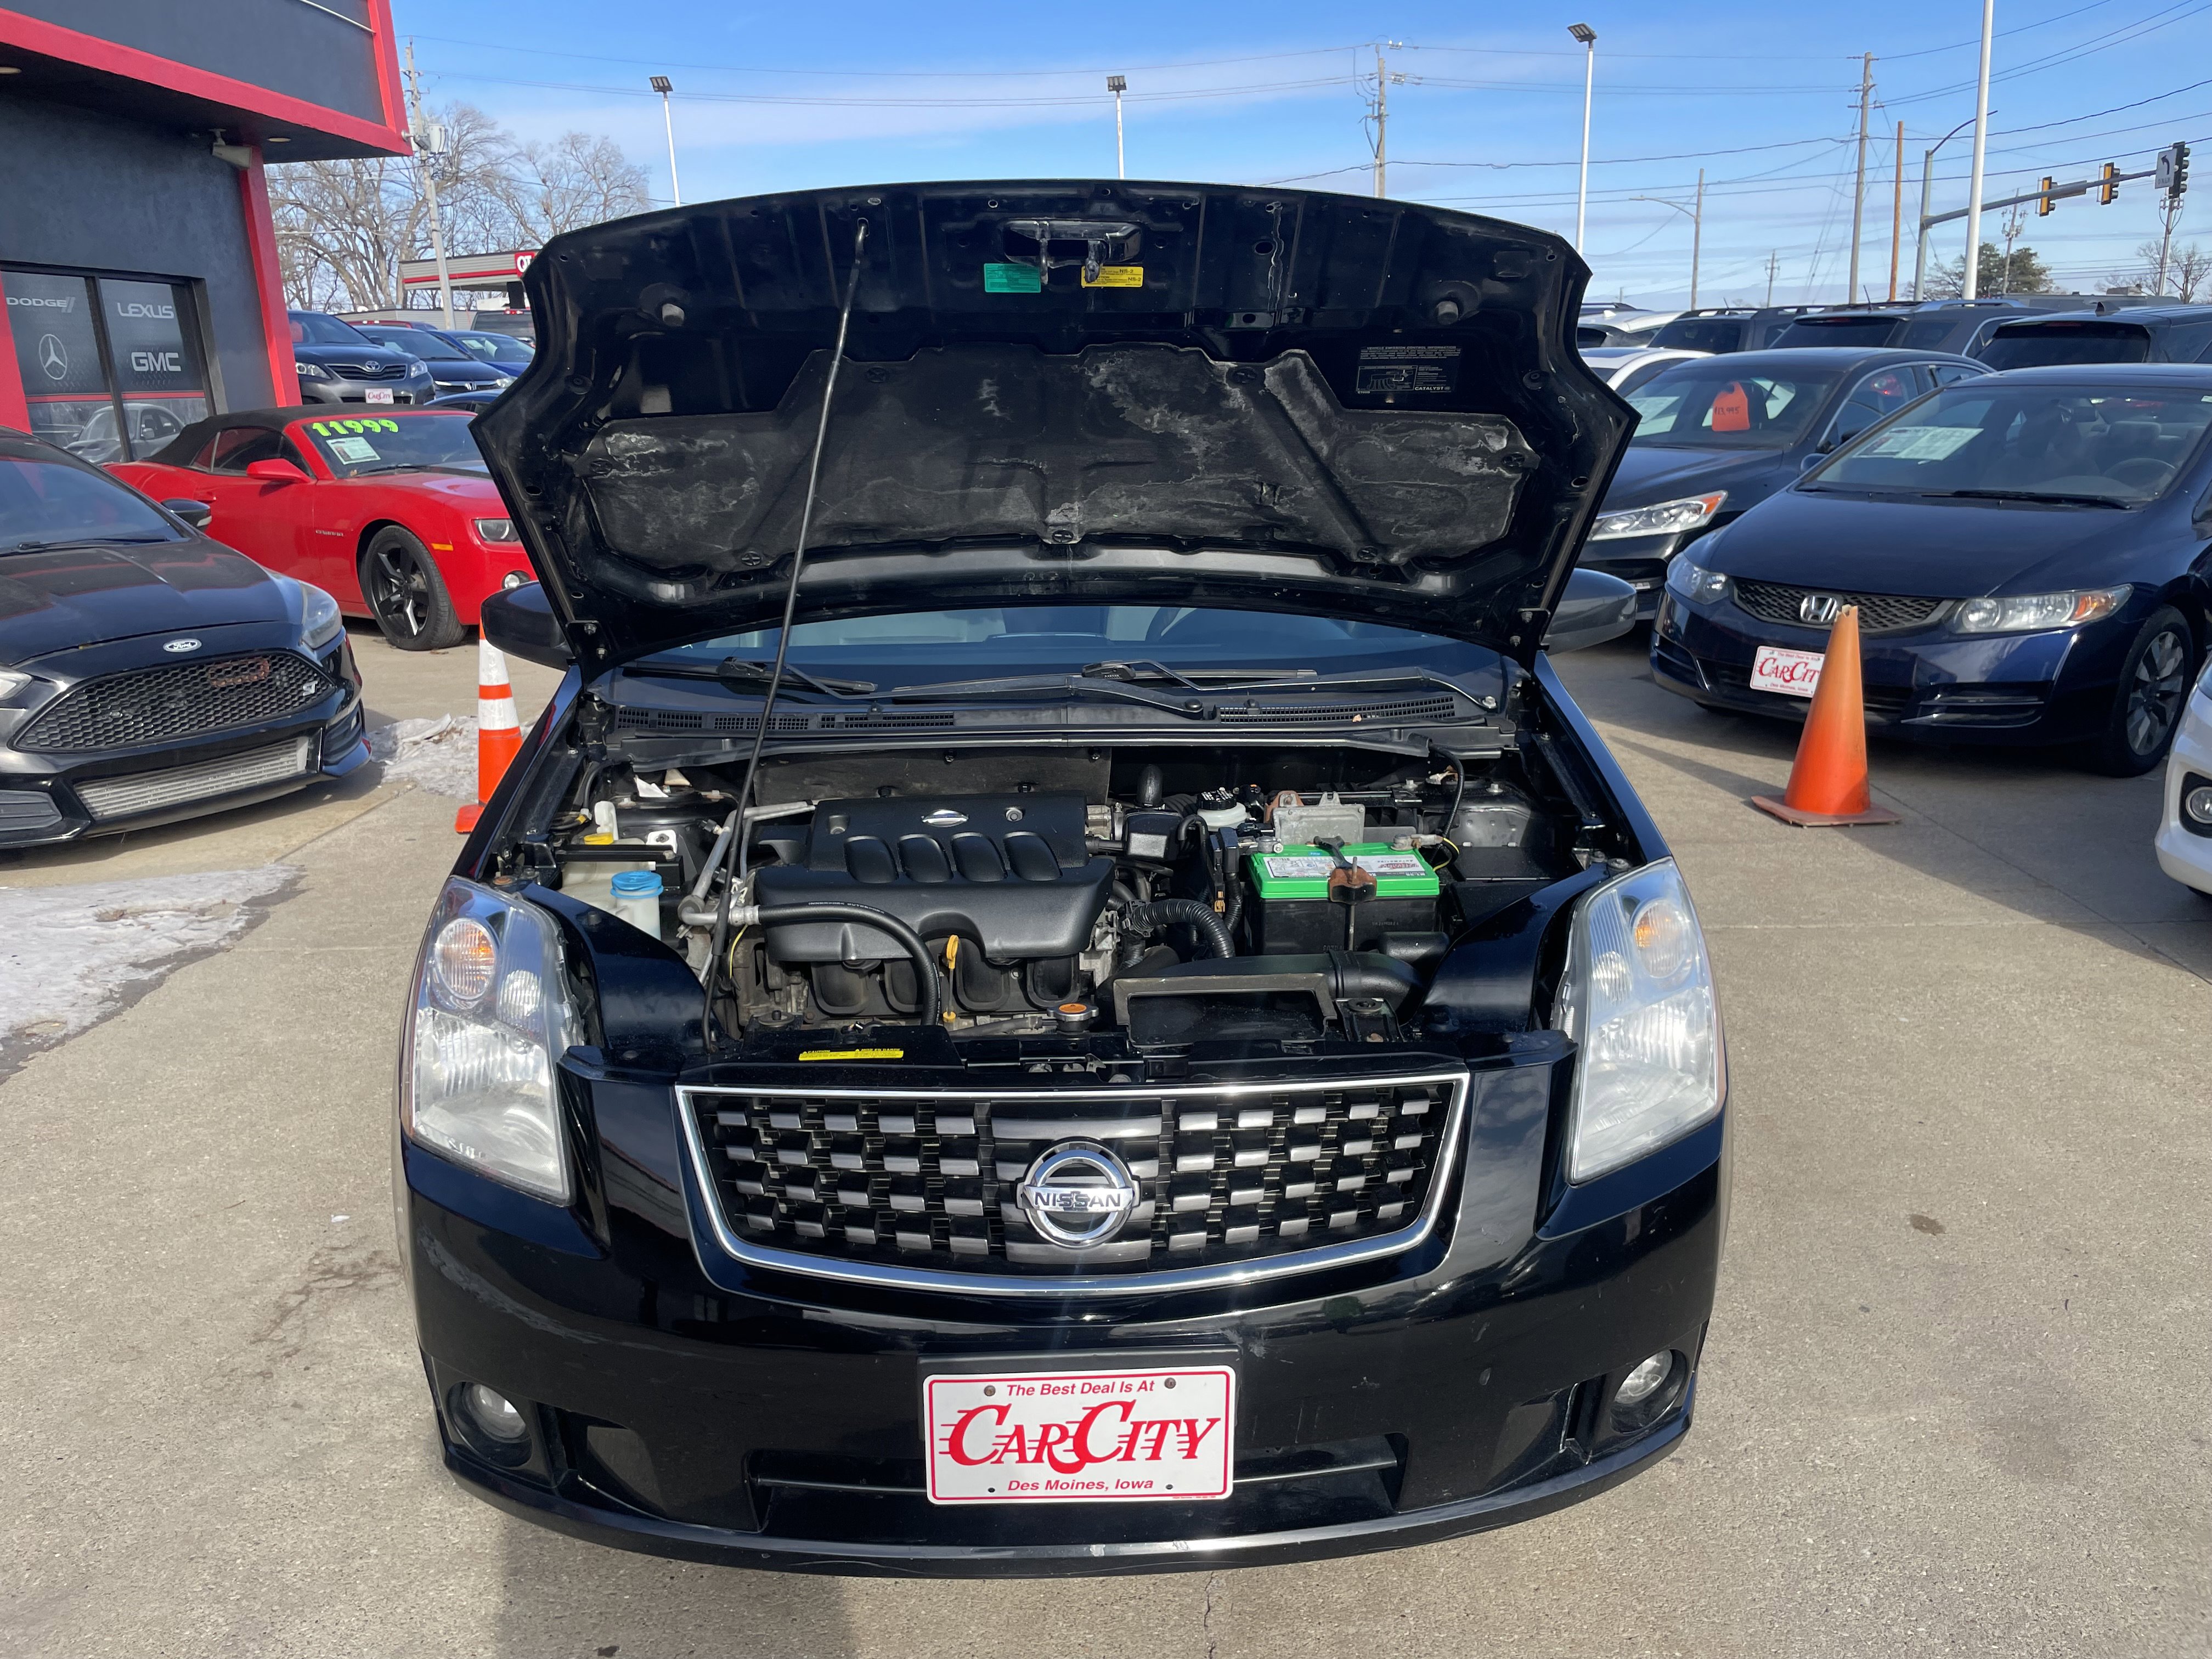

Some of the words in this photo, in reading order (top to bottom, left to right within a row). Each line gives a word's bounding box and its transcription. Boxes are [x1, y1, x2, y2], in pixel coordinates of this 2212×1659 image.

[517, 255, 532, 273] QT
[6, 297, 67, 308] DODGE
[117, 302, 174, 319] LEXUS
[131, 352, 181, 371] GMC
[312, 419, 399, 437] 11999
[1035, 1191, 1121, 1207] NISSAN
[1007, 1385, 1035, 1396] The
[1040, 1384, 1076, 1395] Best
[1081, 1381, 1115, 1394] Deal
[1120, 1381, 1133, 1393] Is
[1137, 1380, 1155, 1392] At
[1008, 1480, 1040, 1491] Des
[1045, 1479, 1109, 1491] Moines,
[1115, 1479, 1154, 1489] Iowa
